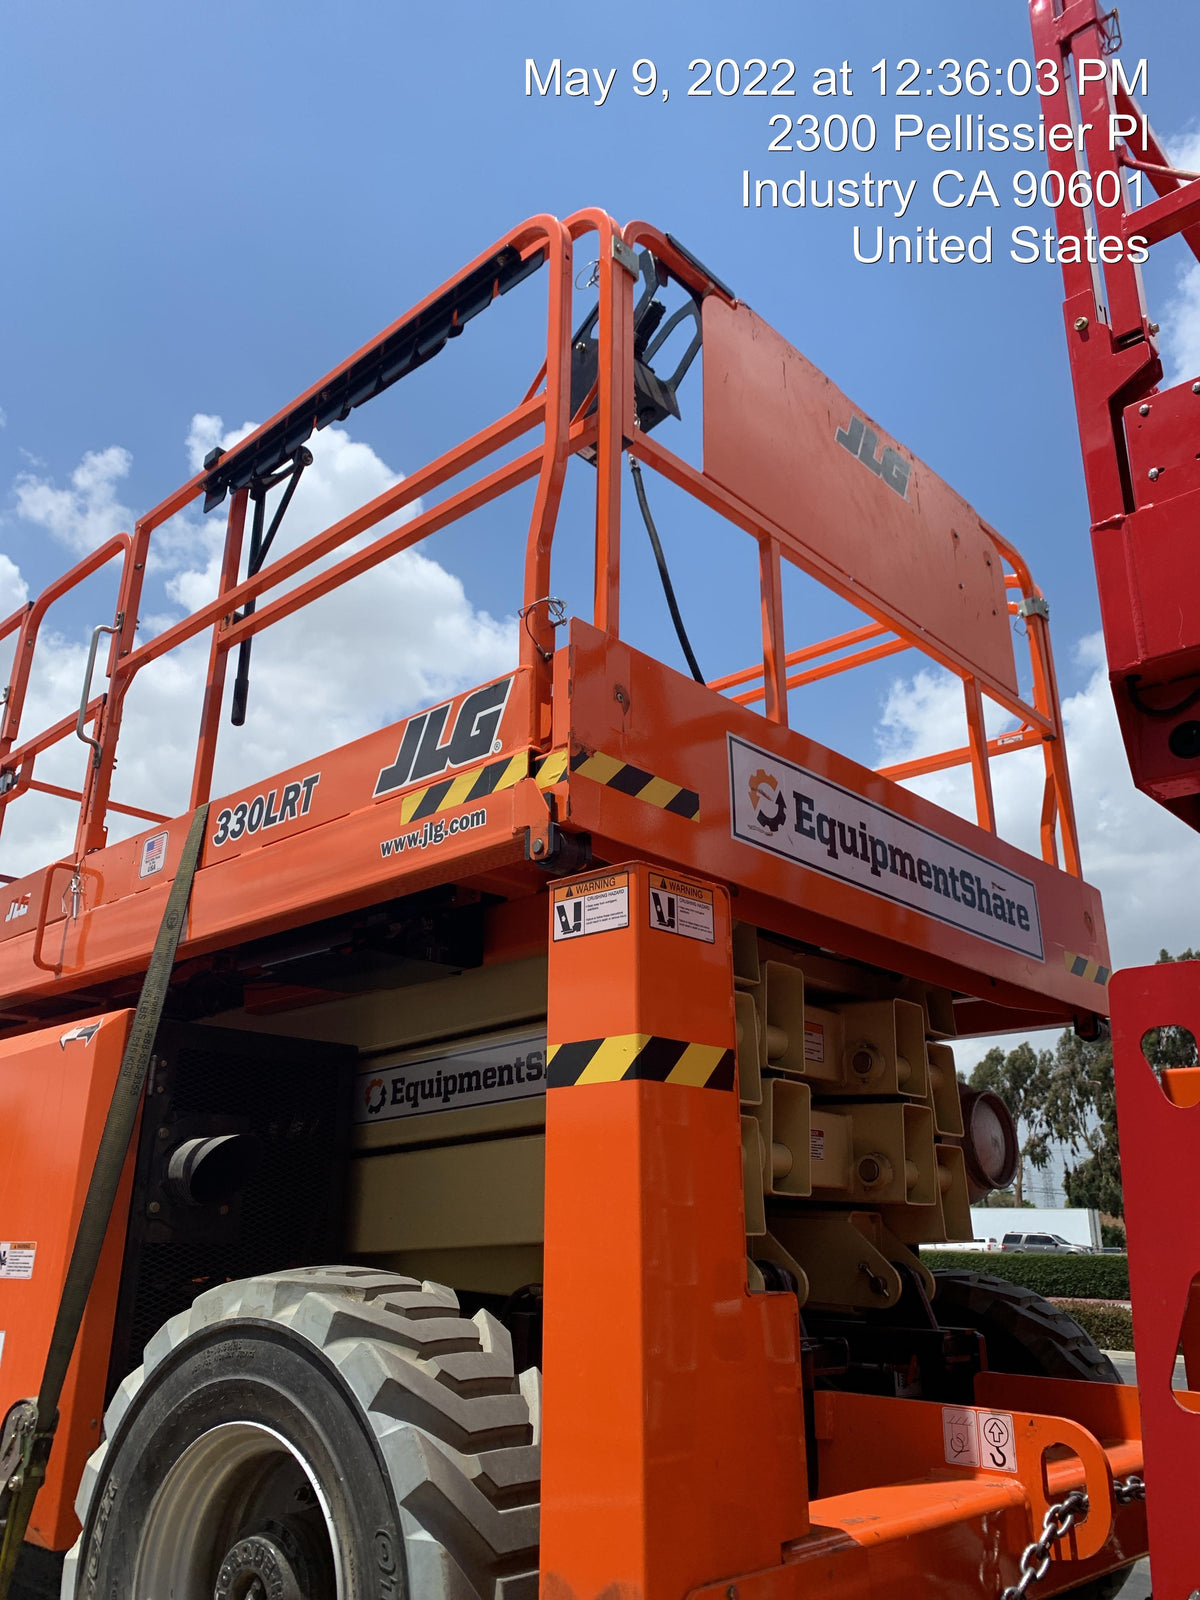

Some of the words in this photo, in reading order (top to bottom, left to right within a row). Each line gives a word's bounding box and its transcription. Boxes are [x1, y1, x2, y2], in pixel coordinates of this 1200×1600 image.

[834, 414, 911, 500] JLG
[372, 675, 516, 799] JLG
[213, 771, 321, 847] 330LRT
[380, 808, 487, 858] www.jlg.com
[575, 877, 616, 895] WARNING
[669, 881, 704, 899] WARNING
[792, 789, 1030, 933] EquipmentShare
